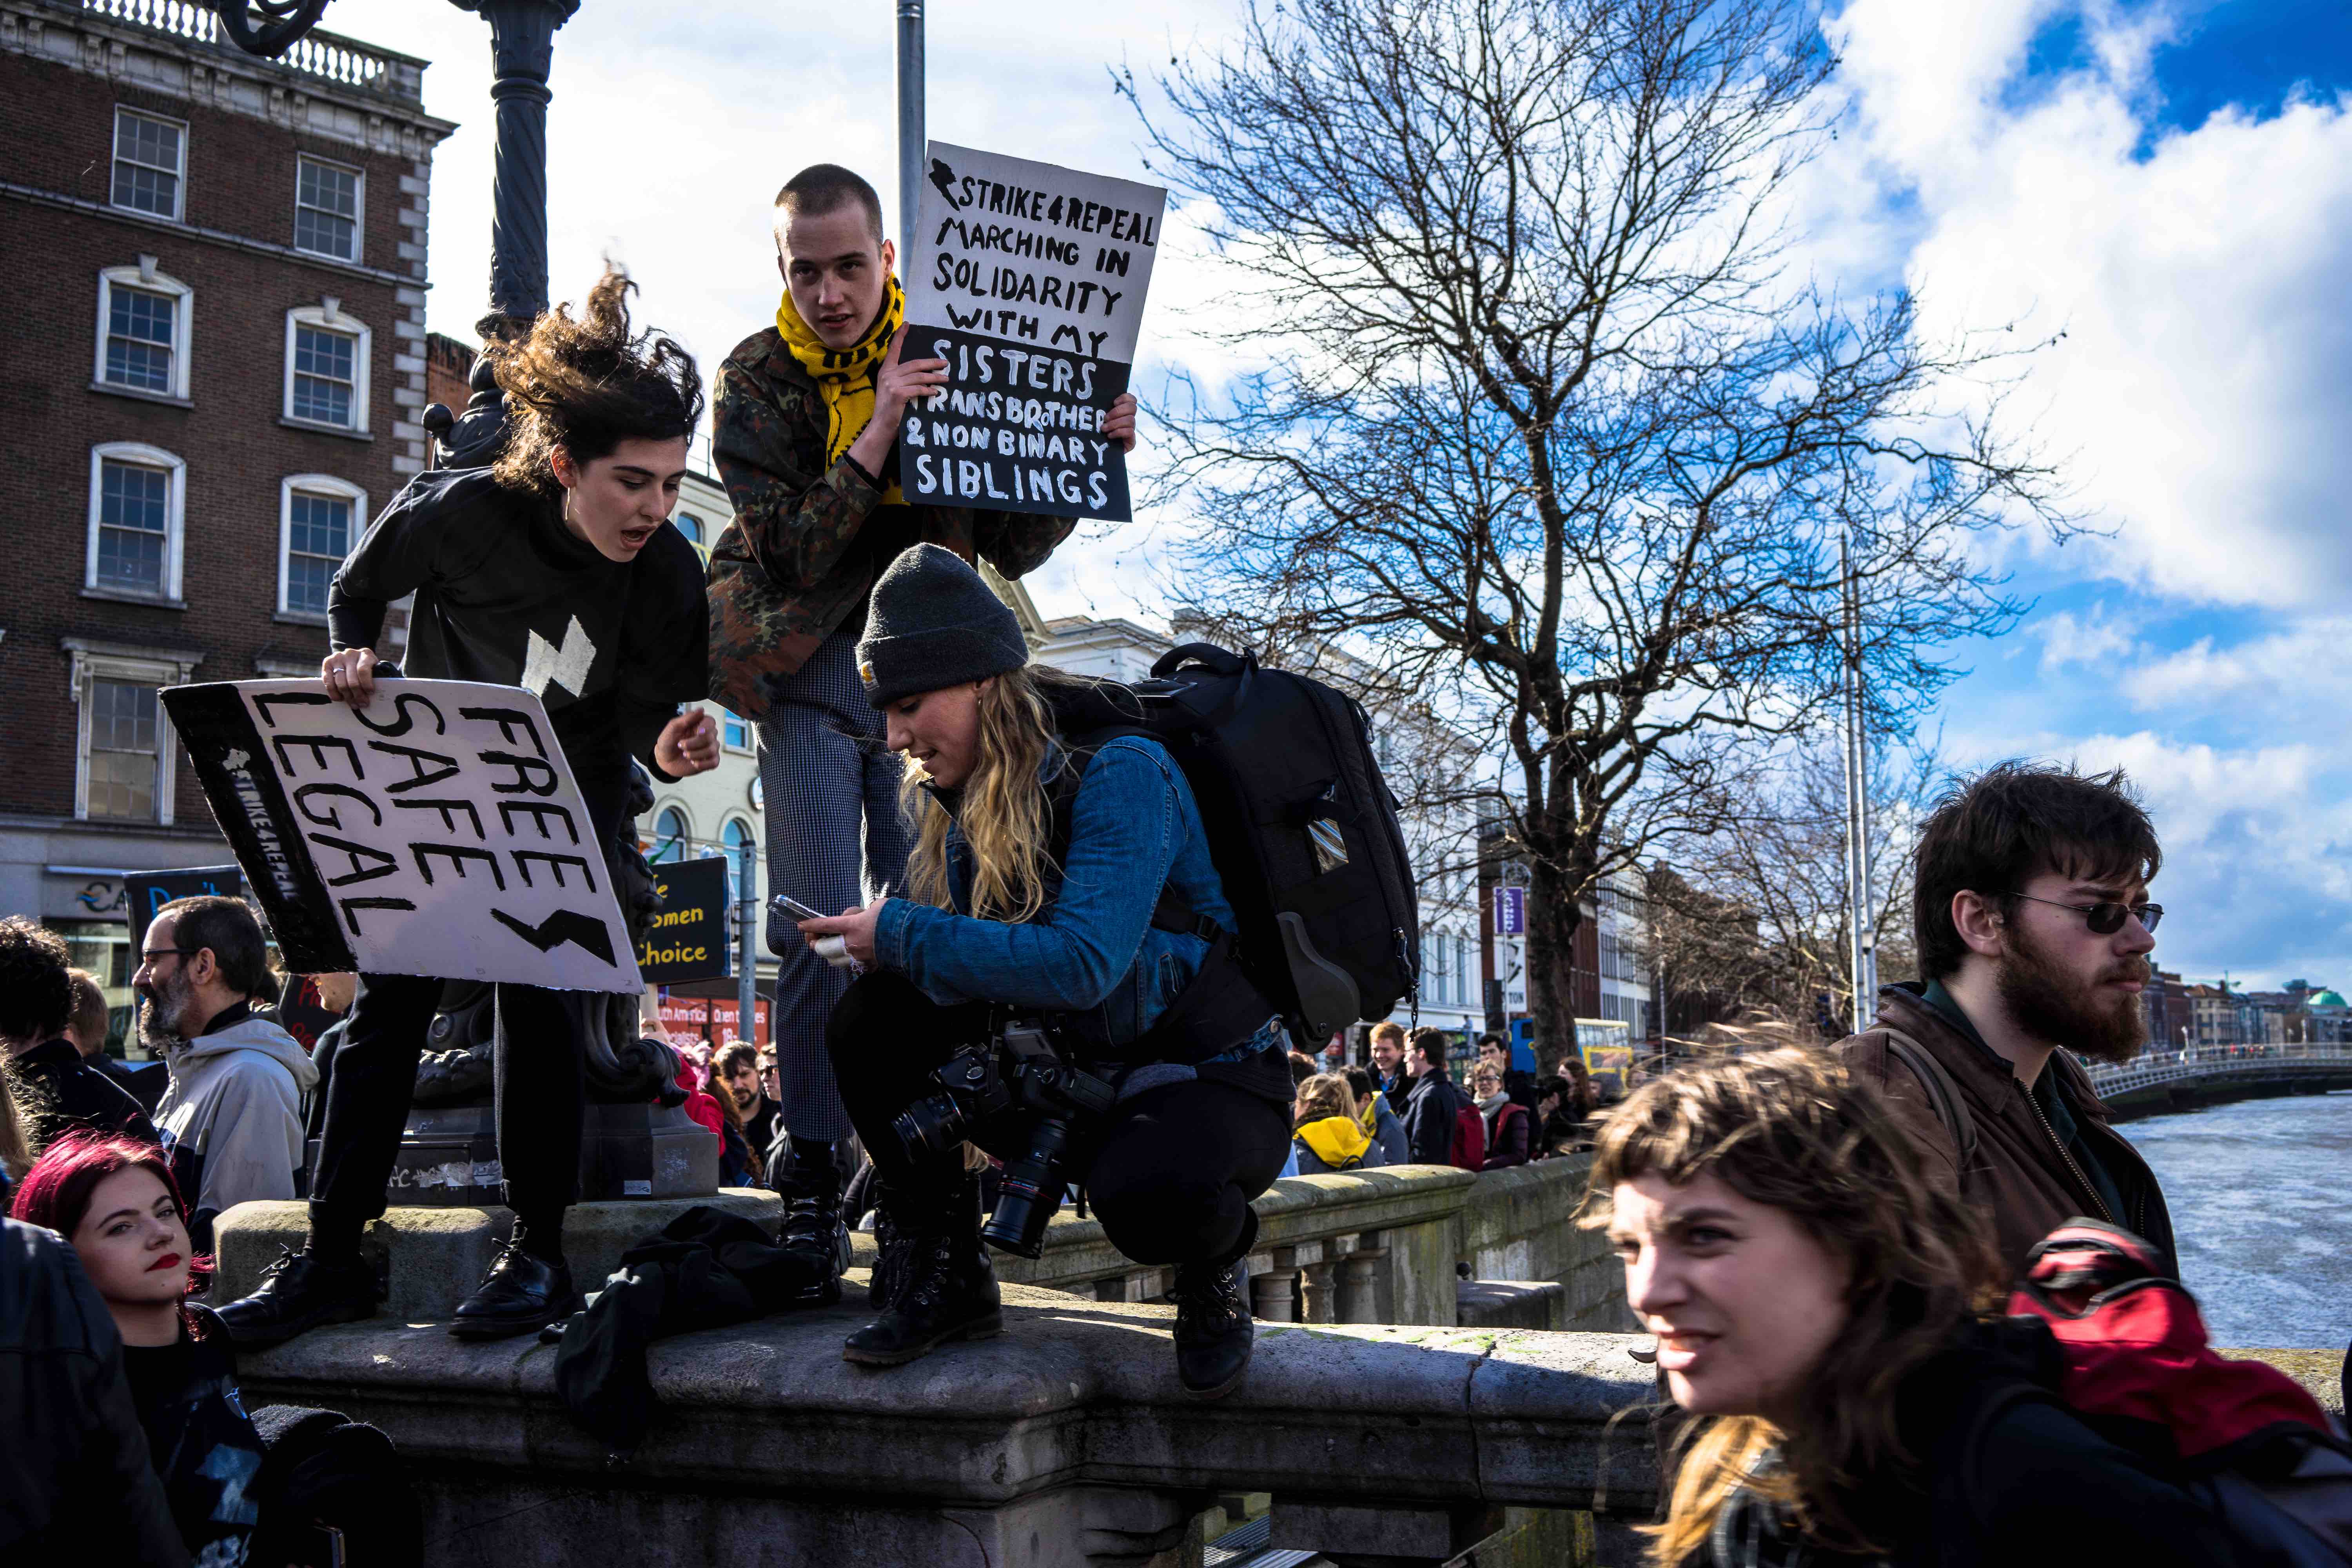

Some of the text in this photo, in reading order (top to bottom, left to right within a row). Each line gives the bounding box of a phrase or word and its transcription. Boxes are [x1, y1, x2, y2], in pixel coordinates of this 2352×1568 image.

[935, 217, 1130, 277] MARCHING IN
[933, 252, 1122, 317] SOLIDARITY
[946, 303, 1109, 358] WITH MY
[932, 339, 1097, 400] SISTERS
[911, 385, 1003, 421] RANS
[906, 416, 1110, 466] & NON BINARY
[916, 454, 1107, 510] SIBLINGS
[251, 691, 418, 937] LEGAL
[352, 693, 506, 891] SAFE
[458, 707, 597, 893] FREE
[652, 907, 704, 928] omen
